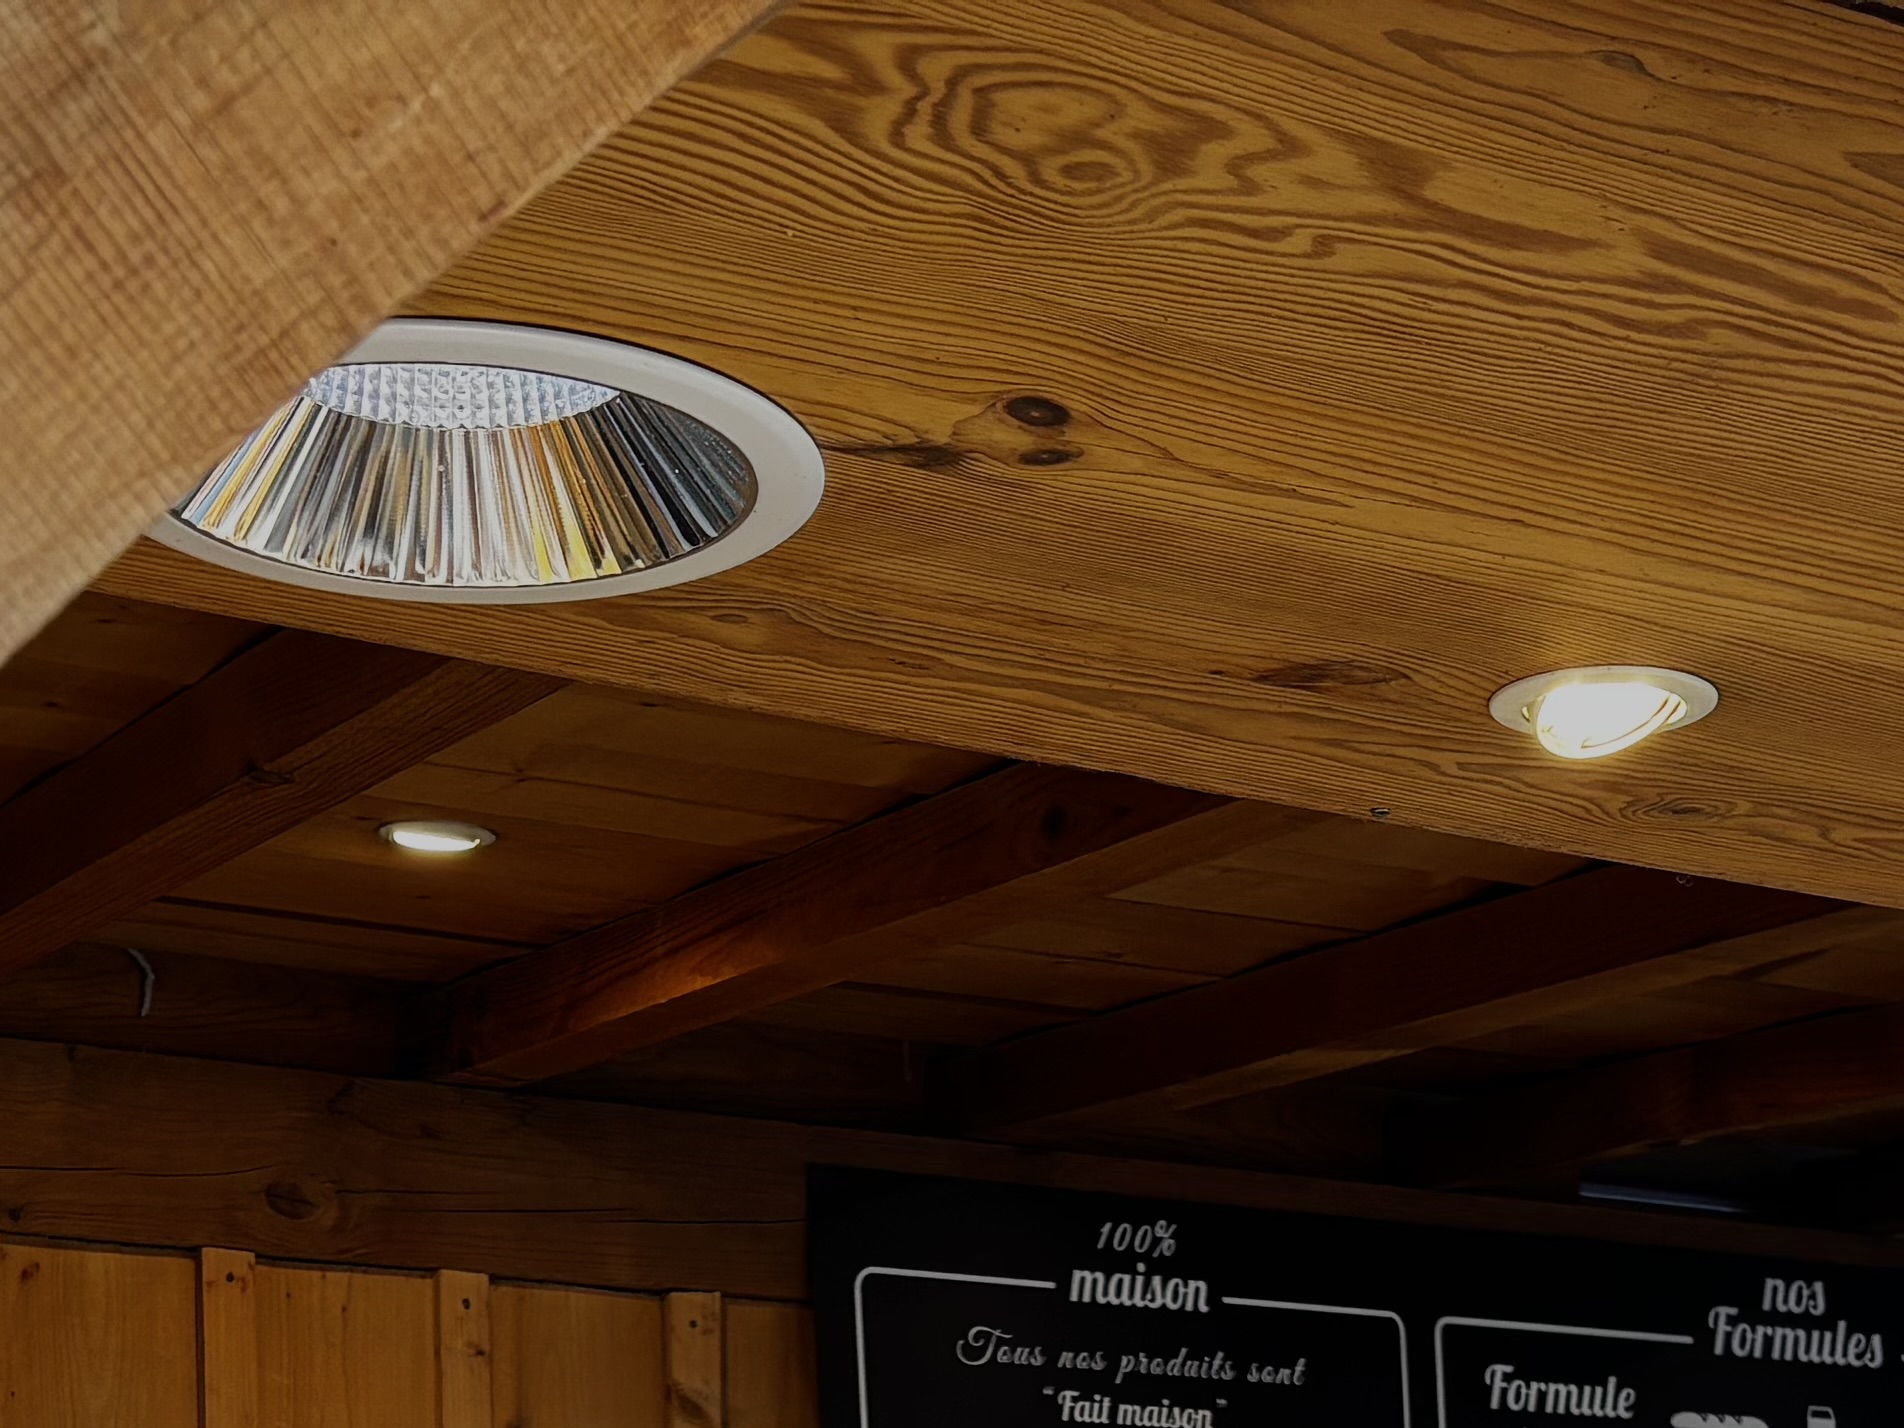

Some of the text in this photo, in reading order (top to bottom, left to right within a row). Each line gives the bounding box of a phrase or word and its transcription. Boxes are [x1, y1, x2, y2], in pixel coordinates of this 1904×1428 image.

[1097, 1220, 1177, 1257] 100%
[1068, 1262, 1210, 1313] maison
[1763, 1275, 1827, 1316] nos
[956, 1325, 1306, 1386] Tous nos produits sont
[1708, 1305, 1885, 1369] Formules
[1484, 1363, 1636, 1421] Formule
